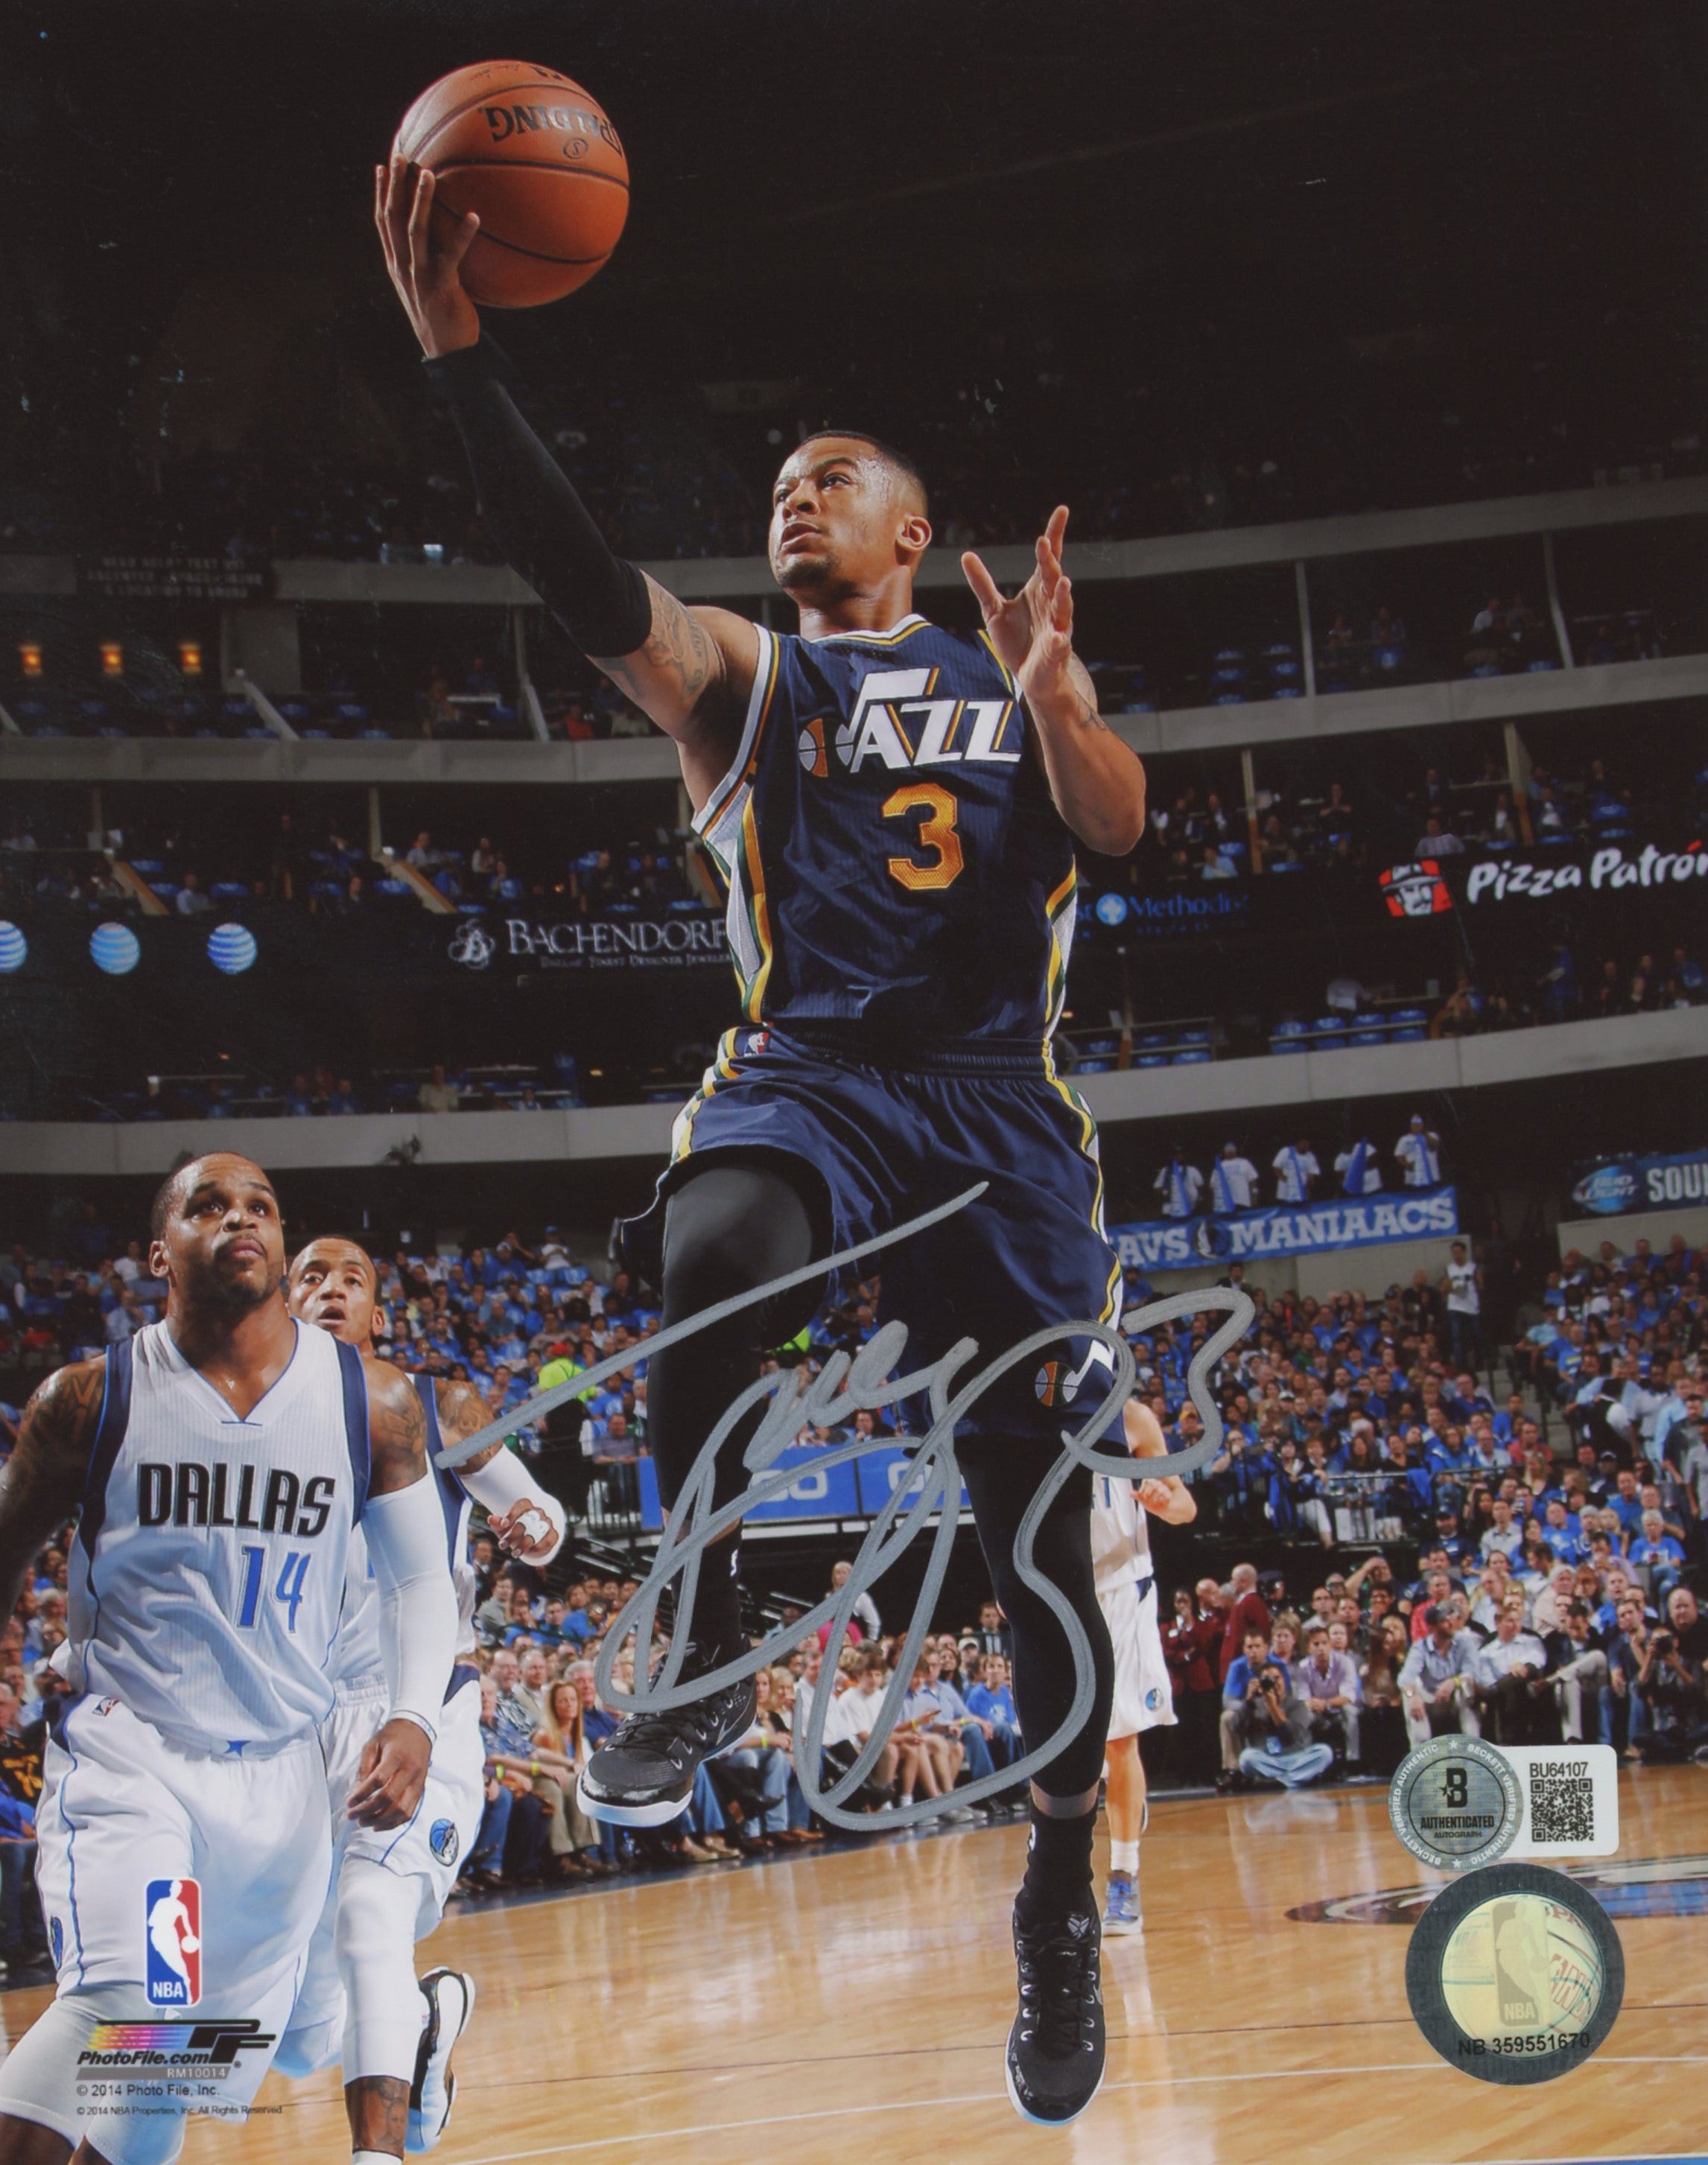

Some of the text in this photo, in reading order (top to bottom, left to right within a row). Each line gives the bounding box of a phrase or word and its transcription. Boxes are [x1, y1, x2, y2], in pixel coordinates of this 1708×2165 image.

[835, 667, 1022, 773] JAZZ
[882, 783, 964, 890] 3
[1467, 860, 1582, 905] Pizza
[1108, 1195, 1455, 1267] AVS MANIAACS
[137, 1462, 336, 1538] DALLAS
[236, 1545, 311, 1633] 14
[1392, 1744, 1442, 1866] BECKETT VERIFIED AUTHENTIC
[1467, 1743, 1517, 1865] BECKETT VERIFIED AUTHENTIC
[1529, 1761, 1589, 1778] BU64107
[1420, 1815, 1494, 1830] AUTHENTICATED
[1433, 1831, 1482, 1839] AUTOGRAPH
[1458, 2032, 1590, 2056] NB 359551670
[1504, 2002, 1535, 2021] NBA
